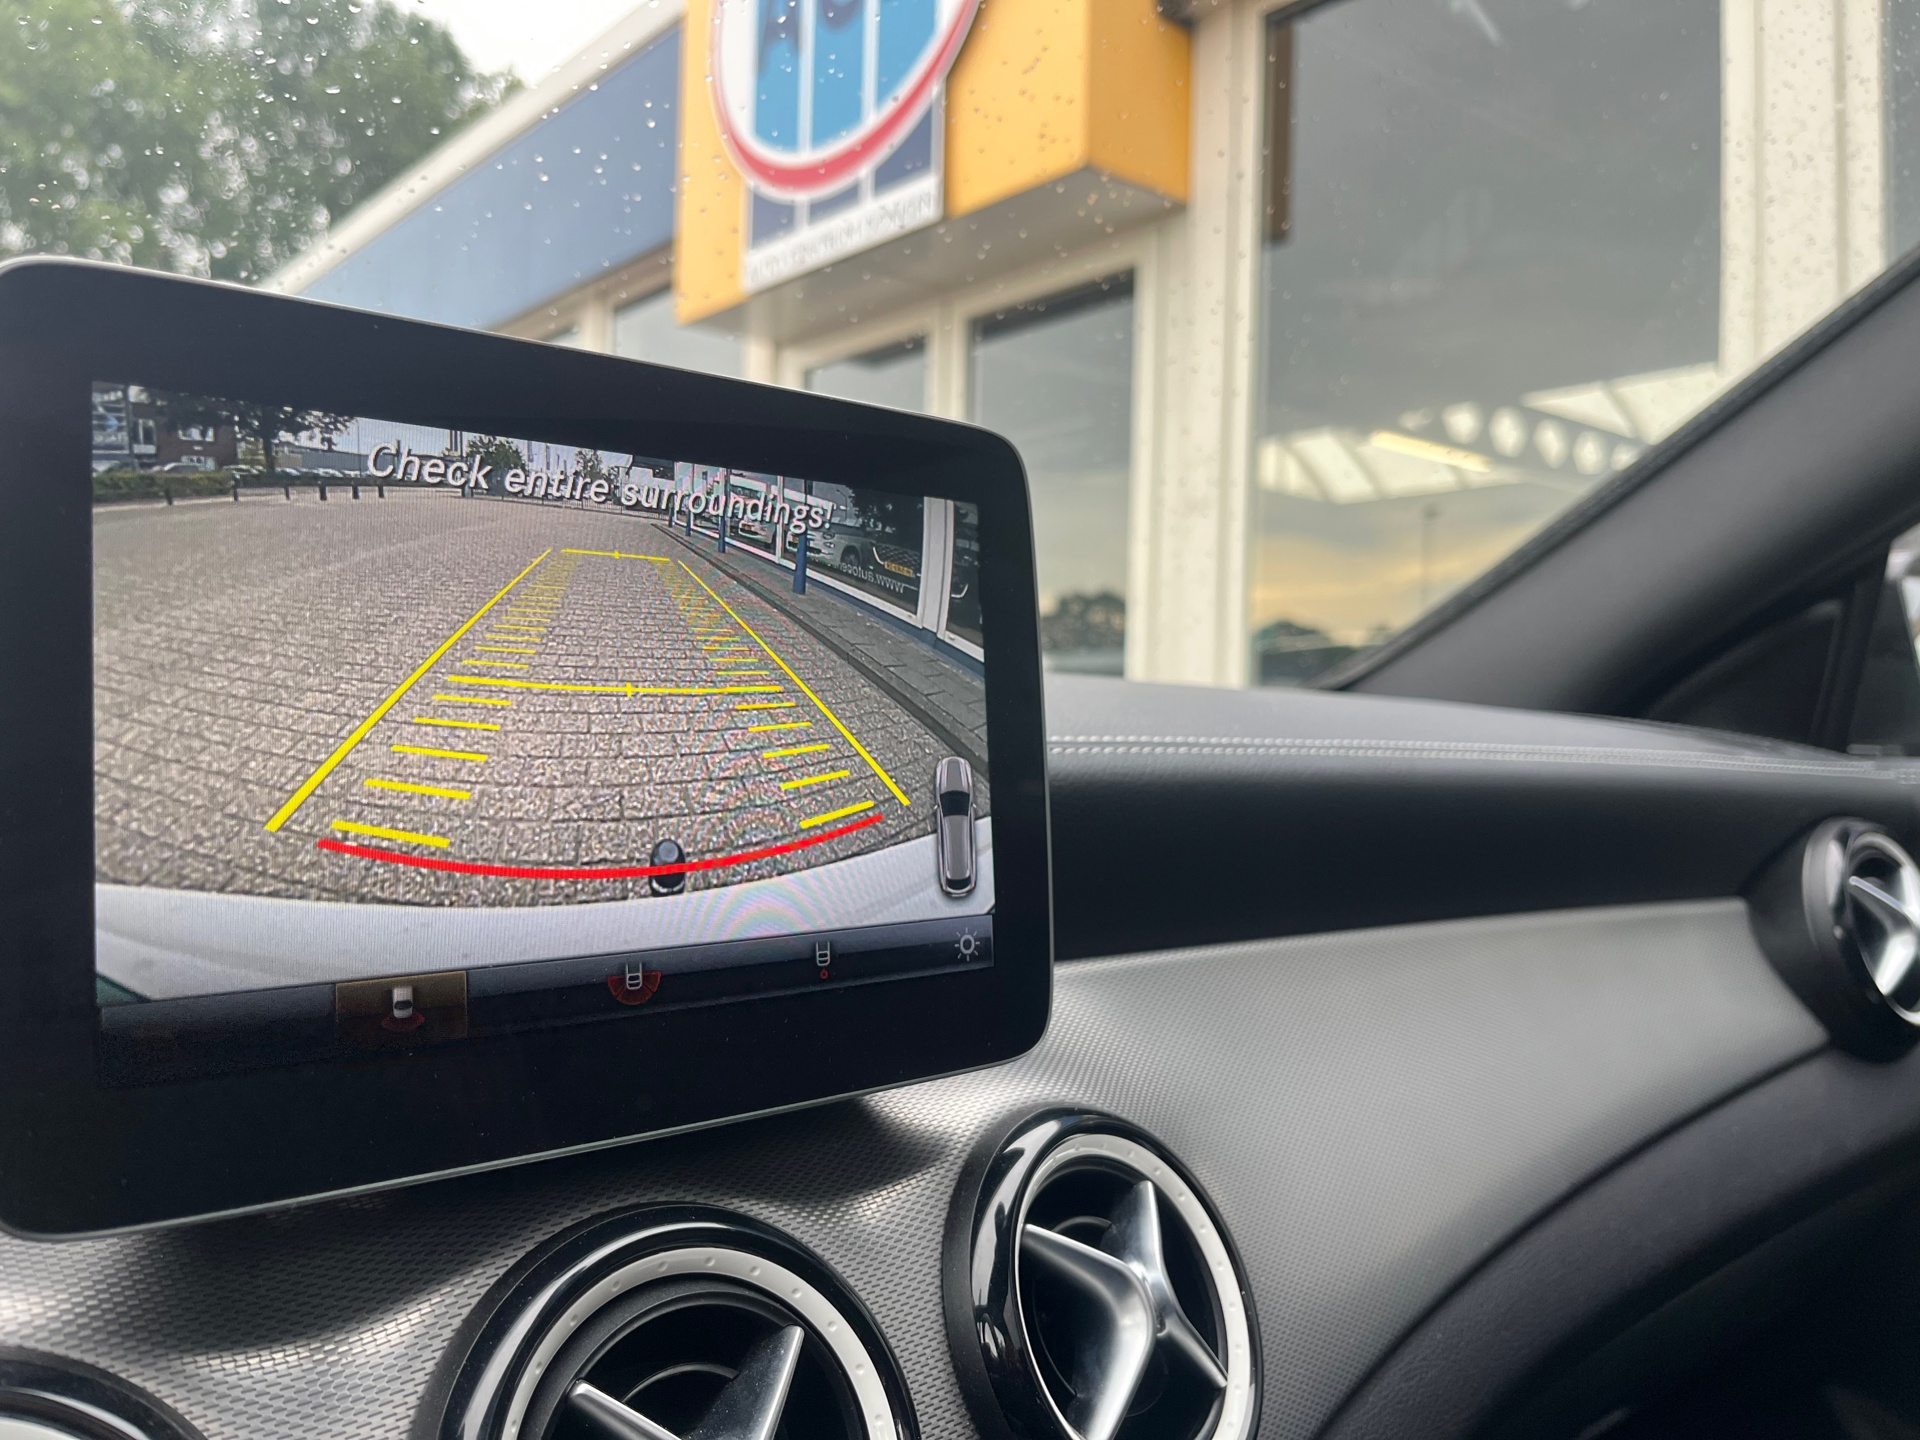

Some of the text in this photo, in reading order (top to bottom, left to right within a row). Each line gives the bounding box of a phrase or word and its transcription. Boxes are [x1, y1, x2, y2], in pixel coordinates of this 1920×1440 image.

[367, 442, 836, 534] Check entire surroundings!
